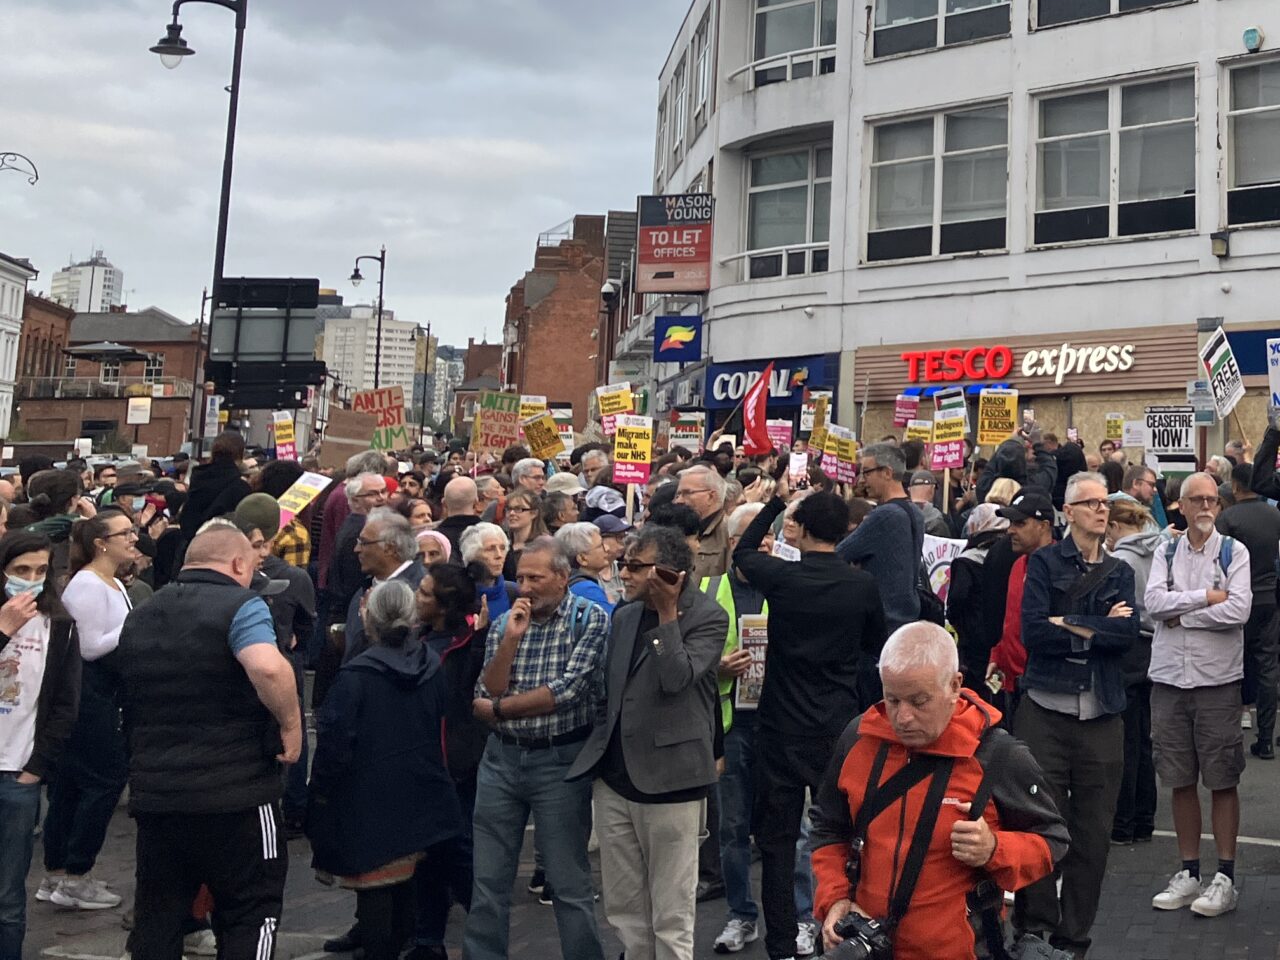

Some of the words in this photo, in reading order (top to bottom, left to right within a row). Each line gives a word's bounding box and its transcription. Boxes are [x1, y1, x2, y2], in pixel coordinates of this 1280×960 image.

[665, 195, 712, 209] MASON
[666, 207, 711, 220] YOUNG
[649, 231, 669, 246] TO
[672, 229, 702, 245] LET
[653, 247, 696, 259] OFFICES
[900, 344, 1014, 382] TESCO
[1021, 343, 1136, 385] express
[1211, 356, 1238, 398] FREE
[1216, 373, 1240, 406] PALESTINE
[352, 389, 402, 411] ANTI-
[982, 396, 1006, 405] SMASH
[981, 408, 1011, 417] FASCISM
[936, 420, 963, 430] Refugees
[980, 420, 986, 429] &
[988, 420, 1014, 430] RACISM
[1146, 414, 1193, 428] CEASEFIRE
[618, 428, 650, 442] Migrants
[616, 440, 638, 450] make
[934, 444, 949, 453] Stop
[949, 442, 960, 451] the
[631, 451, 647, 460] NHS
[933, 454, 943, 462] far
[943, 451, 960, 463] right
[615, 462, 626, 471] Stop
[936, 543, 948, 559] UP
[950, 543, 960, 558] TO
